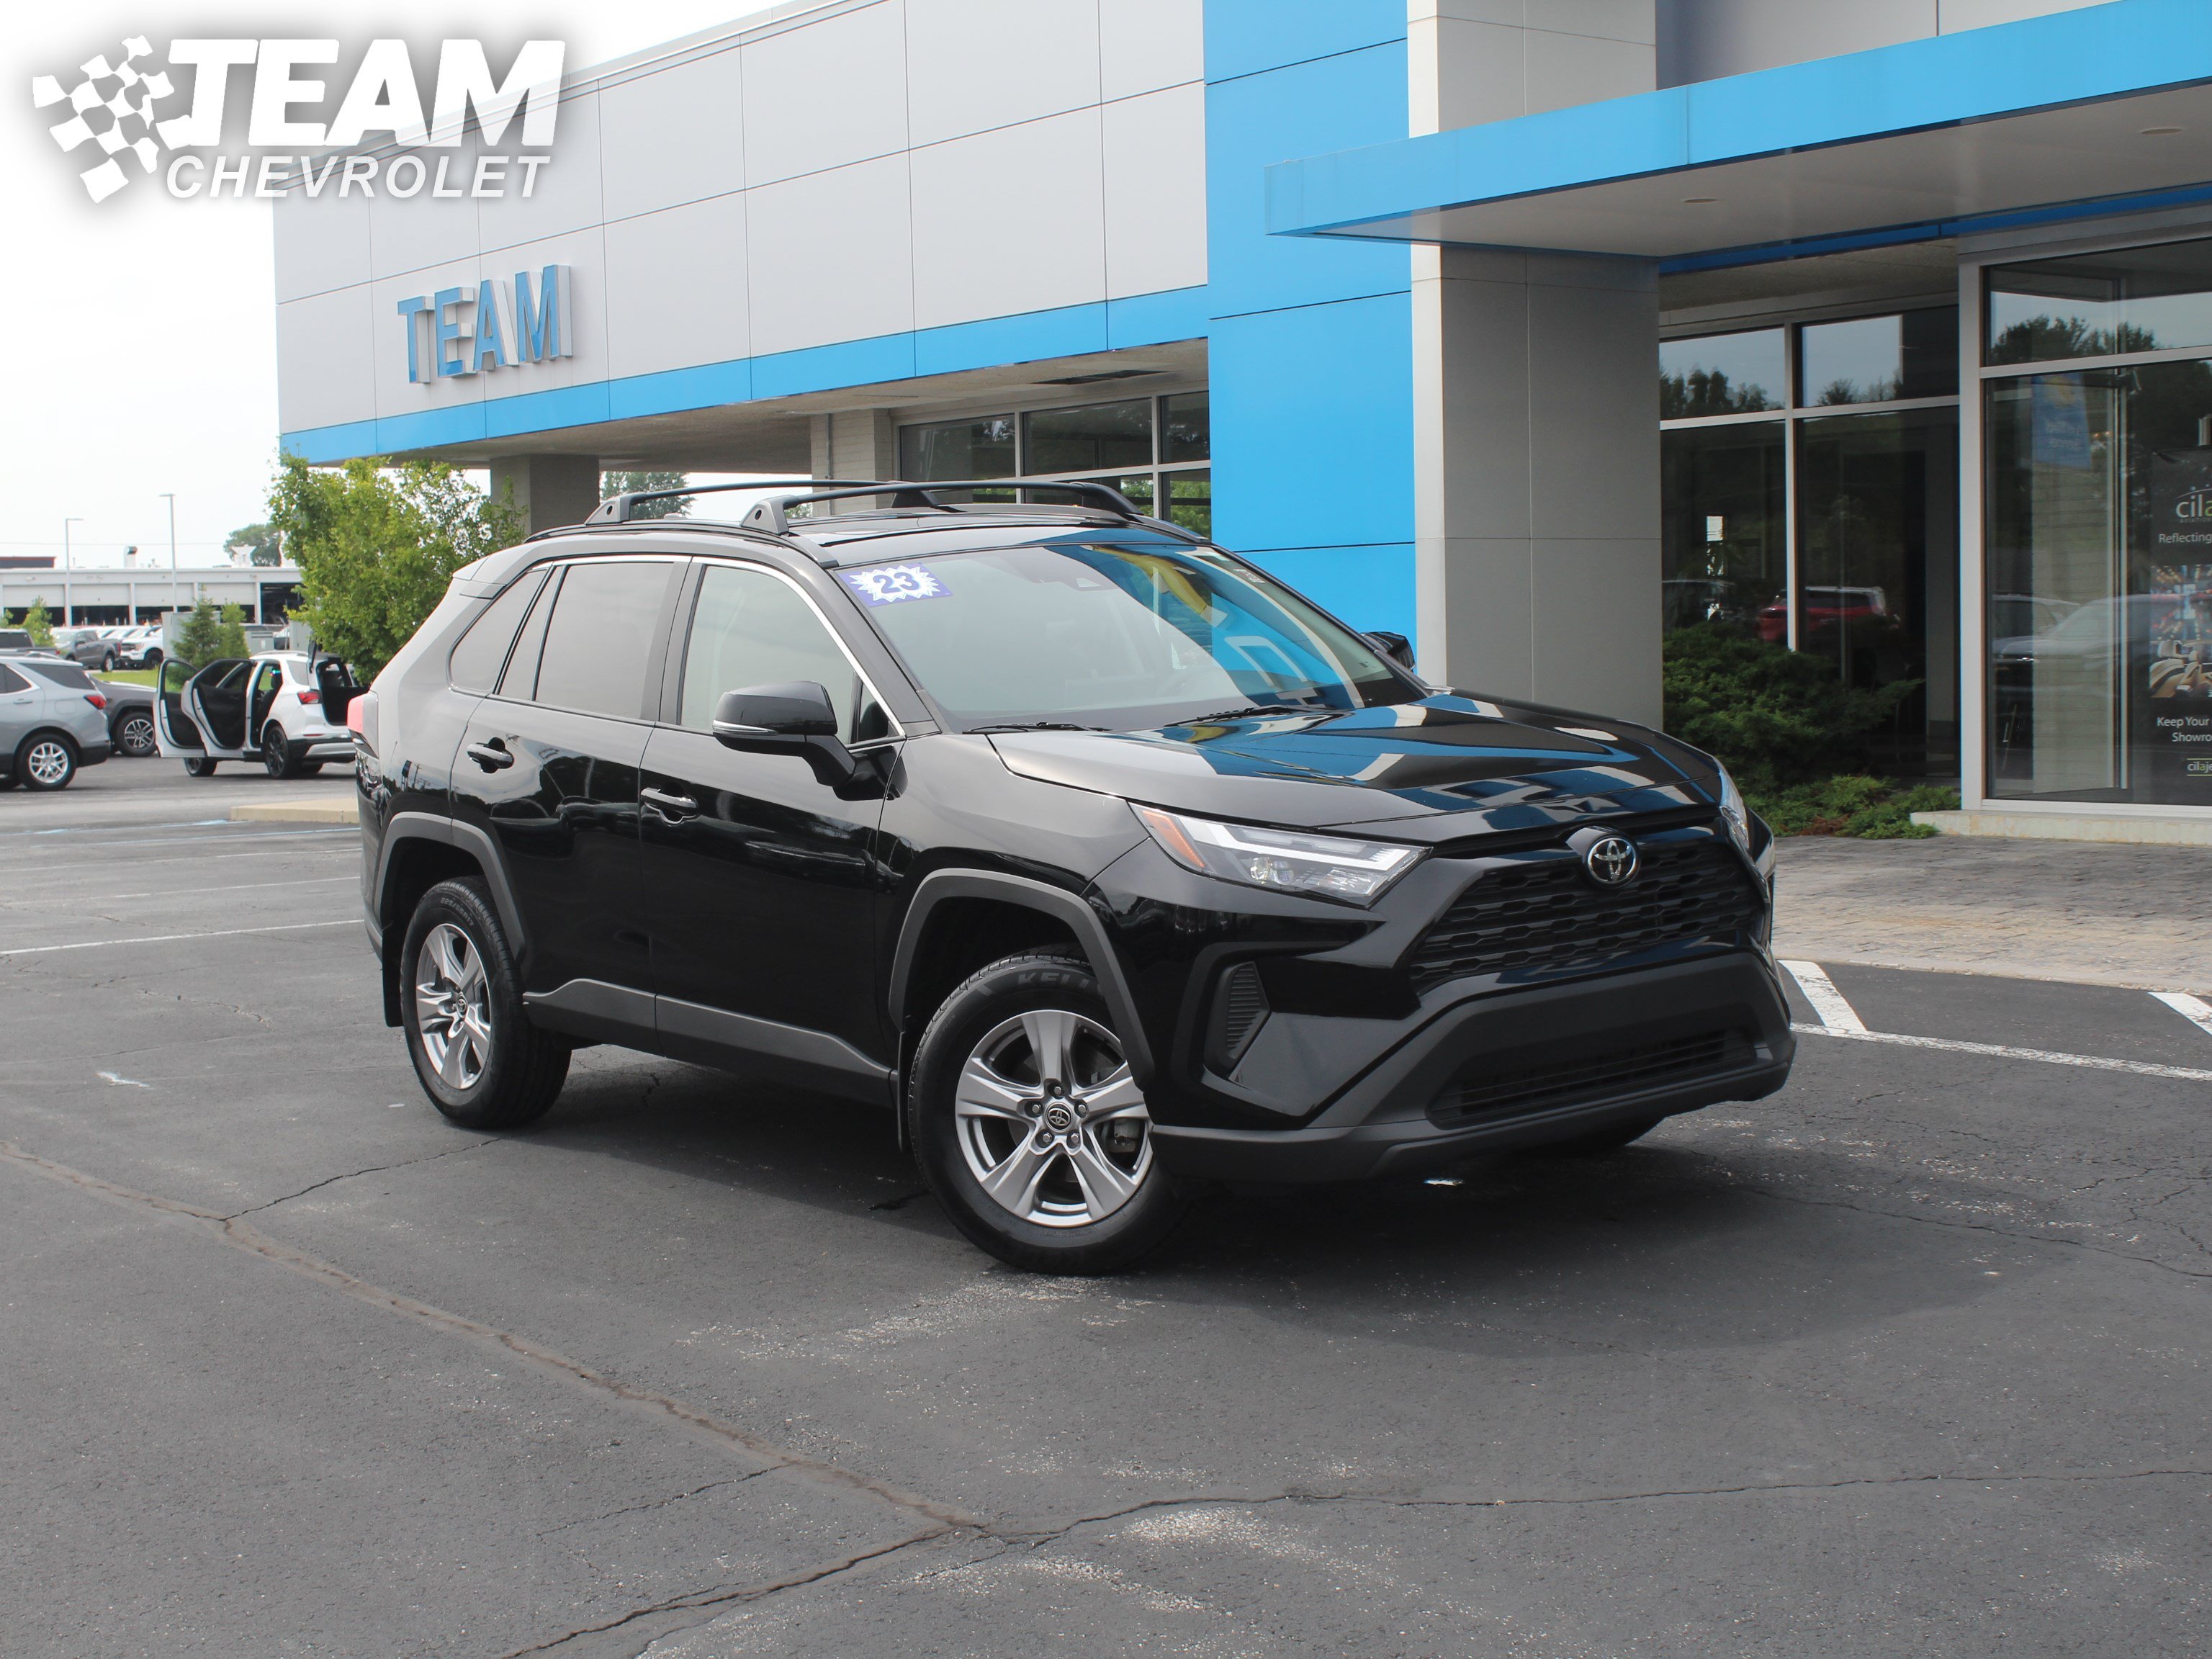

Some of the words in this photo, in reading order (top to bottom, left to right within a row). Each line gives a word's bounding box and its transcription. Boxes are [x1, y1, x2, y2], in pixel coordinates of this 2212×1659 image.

[397, 264, 572, 383] TEAM
[2158, 532, 2212, 544] Reflecting
[873, 572, 920, 594] 23
[2157, 716, 2184, 728] Keep
[2185, 716, 2210, 727] Your
[1017, 972, 1103, 998] KELL
